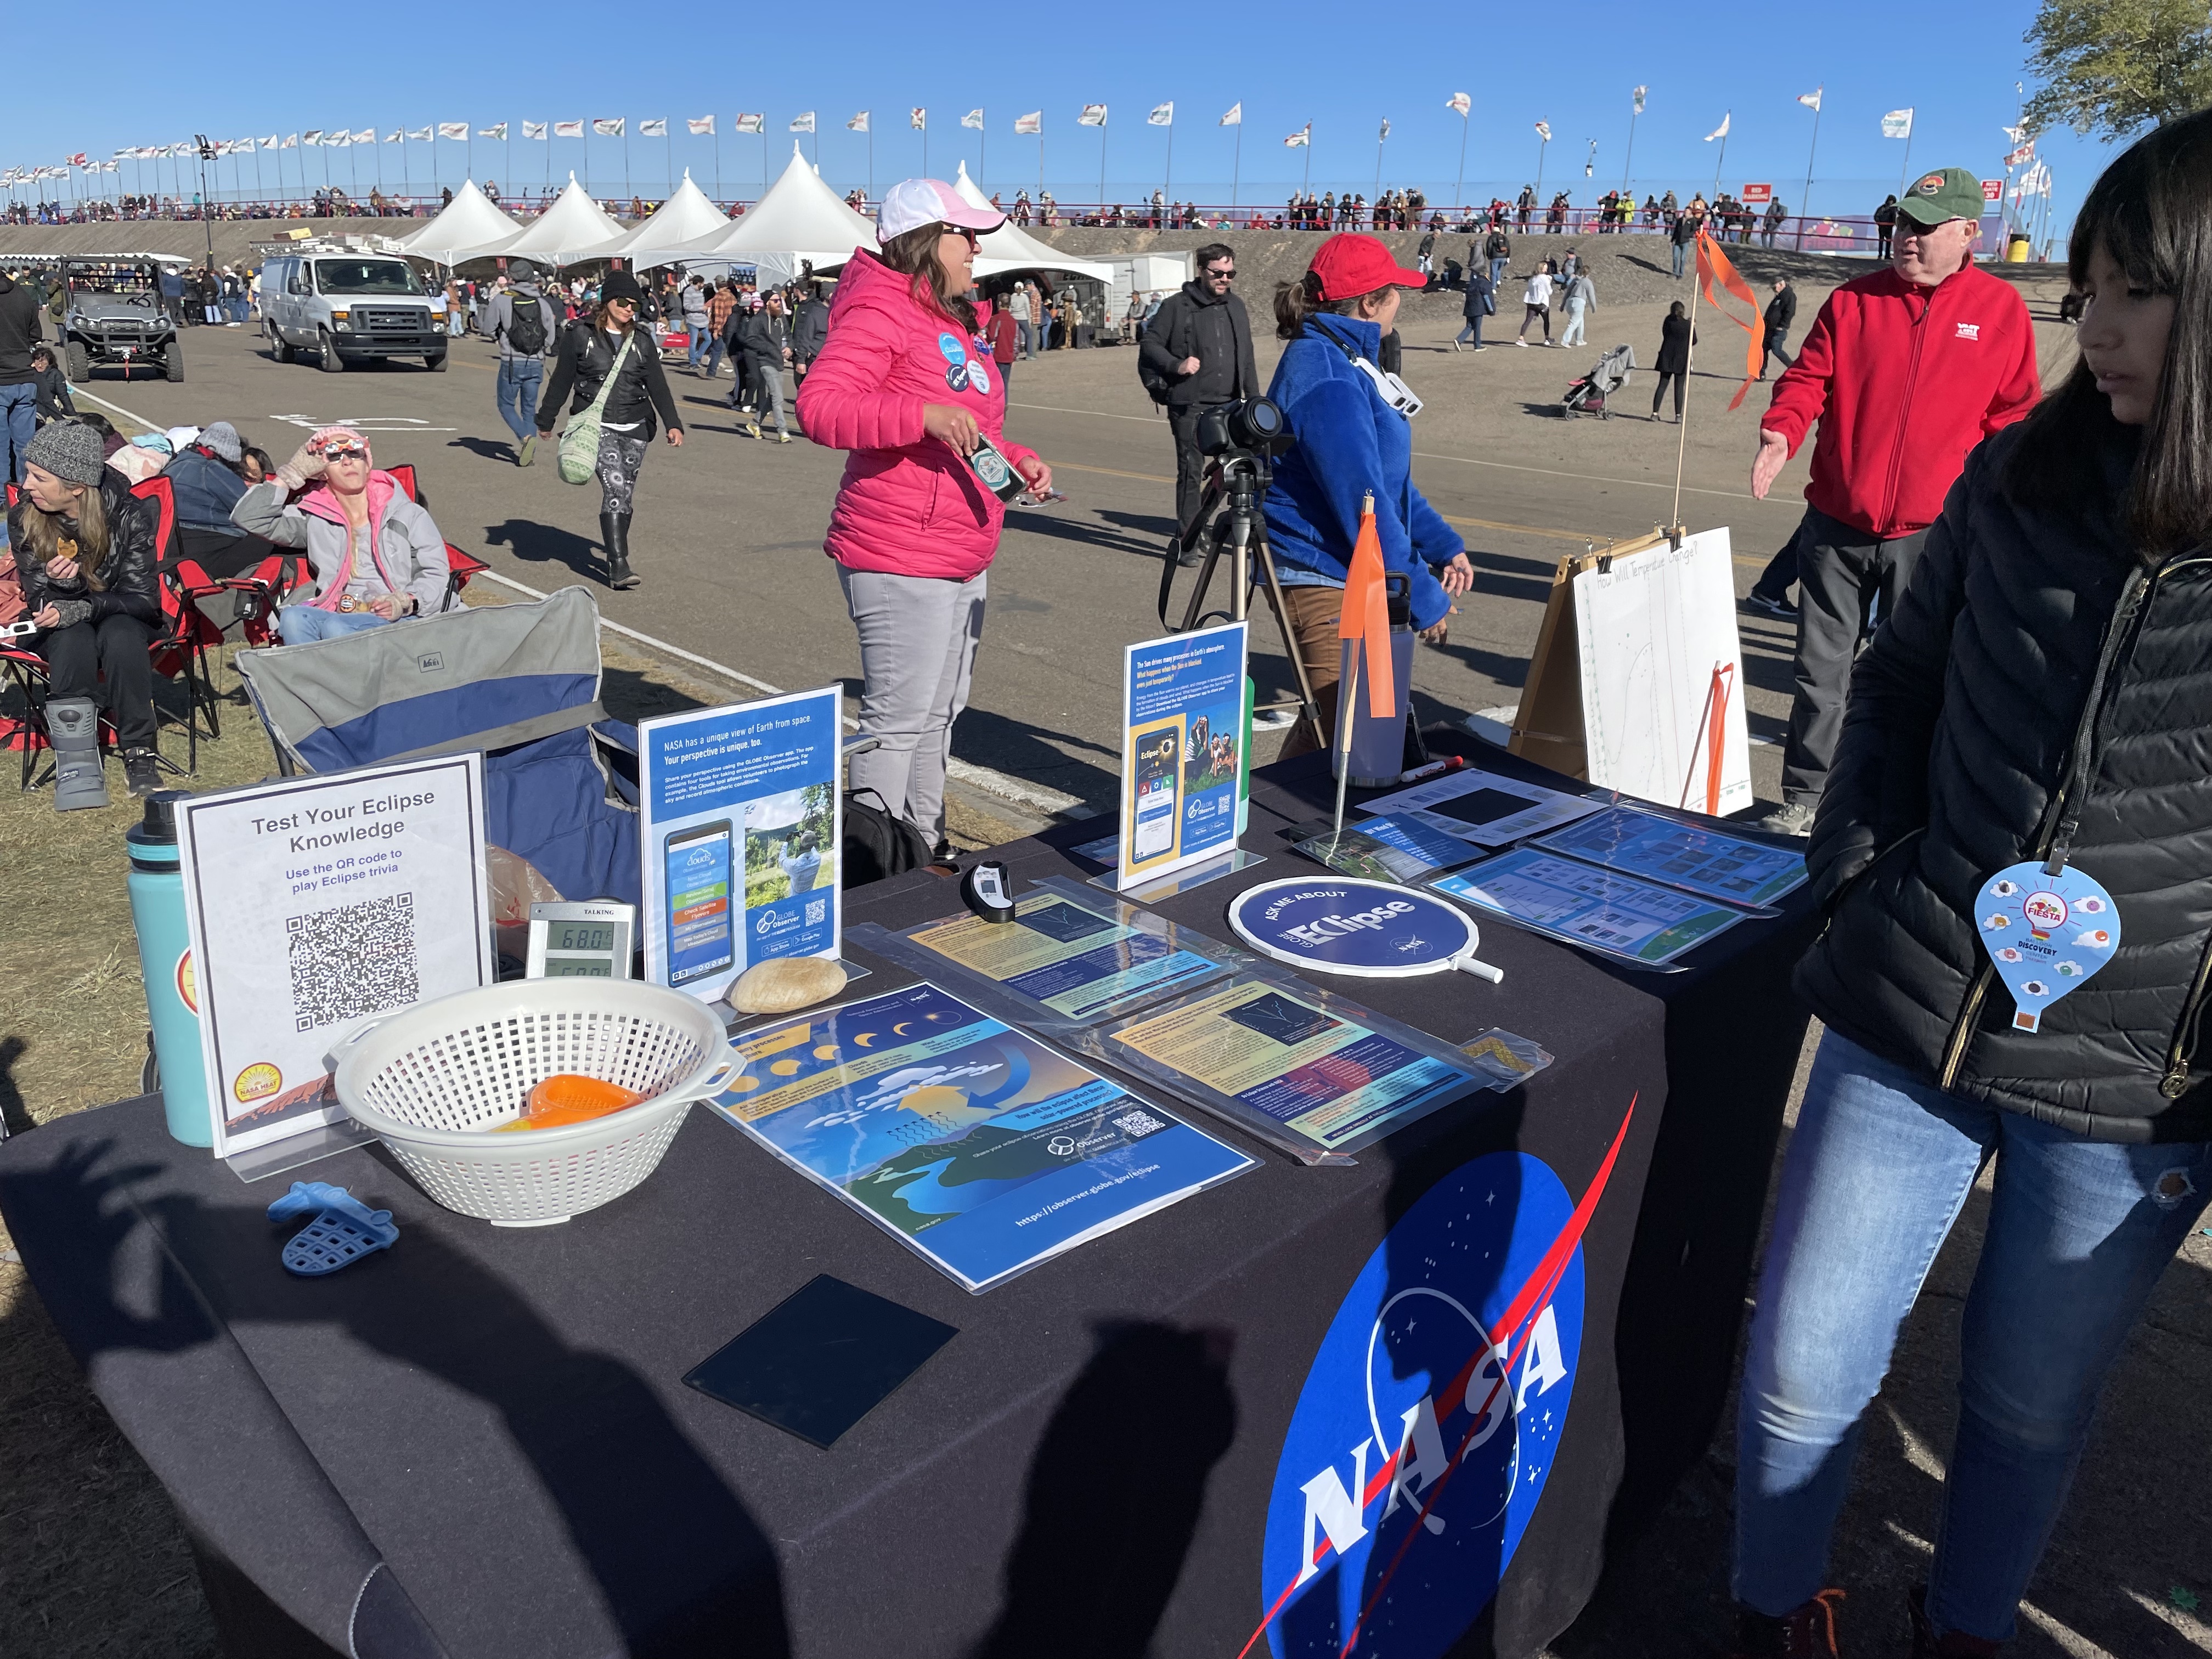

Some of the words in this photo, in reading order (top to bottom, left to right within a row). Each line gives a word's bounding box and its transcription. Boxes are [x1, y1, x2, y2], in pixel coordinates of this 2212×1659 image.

[1804, 237, 1854, 249] FIESTA
[1596, 574, 1611, 590] How
[1613, 564, 1629, 583] Will
[1669, 541, 1698, 566] Change?
[1173, 652, 1189, 663] processes
[1194, 648, 1206, 656] Earth's
[1206, 645, 1225, 653] atmosphere.
[1147, 668, 1161, 677] happens
[1153, 674, 1174, 685] temporarily?
[664, 740, 683, 752] NASA
[685, 737, 698, 748] has
[707, 731, 729, 743] unique
[731, 729, 746, 738] view
[748, 725, 755, 734] of
[757, 721, 773, 733] Earth
[775, 718, 790, 729] from
[792, 715, 812, 726] space.
[664, 756, 679, 765] Your
[681, 748, 718, 764] perspective
[720, 746, 725, 754] is
[727, 741, 749, 753] unique,
[751, 738, 762, 747] too.
[1141, 749, 1159, 759] Eclipse
[693, 766, 721, 778] perspective
[723, 763, 736, 771] using
[746, 757, 763, 765] GLOBE
[763, 752, 784, 761] Observer
[665, 781, 687, 790] contains
[720, 770, 735, 778] taking
[736, 762, 769, 774] environmental
[770, 755, 800, 766] observations.
[665, 788, 688, 797] example,
[698, 781, 715, 789] Clouds
[743, 769, 768, 779] volunteers
[774, 761, 800, 771] photograph
[686, 791, 702, 799] record
[703, 785, 733, 794] atmospheric
[733, 778, 760, 788] conditions.
[251, 814, 299, 834] Test
[306, 805, 355, 824] Your
[363, 792, 435, 815] Eclipse
[1198, 806, 1215, 815] Observer
[290, 821, 405, 853] Knowledge
[286, 868, 309, 879] Use
[313, 864, 332, 874] the
[336, 858, 354, 870] QR
[358, 853, 387, 865] code
[391, 850, 402, 858] to
[687, 853, 710, 867] clouds
[292, 881, 317, 895] play
[322, 871, 366, 887] Eclipse
[369, 864, 398, 877] trivia
[698, 871, 712, 879] Cloud
[686, 877, 713, 888] Observation
[686, 887, 714, 899] Review/Send
[686, 894, 714, 905] Observations
[1294, 890, 1347, 901] ABOUT
[684, 907, 698, 916] Check
[699, 902, 716, 911] Satellite
[1273, 896, 1296, 908] ME
[691, 910, 710, 919] Flyovers
[777, 910, 795, 920] GLOBE
[1265, 903, 1283, 922] ASK
[2028, 907, 2061, 921] FIESTA
[692, 918, 716, 929] Observations
[773, 916, 800, 928] Observer
[562, 929, 603, 949] 68.0
[687, 935, 715, 947] Measurements
[1277, 932, 1313, 948] GLOBE
[2025, 938, 2052, 948] BALLOON
[1398, 940, 1426, 953] NASA
[2018, 940, 2057, 956] DISCOVERY
[865, 1003, 890, 1012] Aeronautics
[873, 1003, 904, 1014] Administration
[753, 1035, 785, 1048] processes
[240, 1086, 259, 1095] NASA
[749, 1090, 787, 1106] Temperature
[1015, 1111, 1030, 1120] How
[1030, 1108, 1041, 1116] will
[1052, 1098, 1073, 1108] eclipse
[1073, 1091, 1091, 1100] affect
[1087, 1085, 1105, 1093] these
[1040, 1102, 1083, 1120] solar-powered
[1082, 1090, 1114, 1106] processes?
[1076, 1132, 1116, 1148] Observer
[1014, 1163, 1160, 1228] https://observer.globe.gov/eclipse
[915, 1217, 941, 1231] nasa.gov
[1295, 1304, 1567, 1589] NASA
